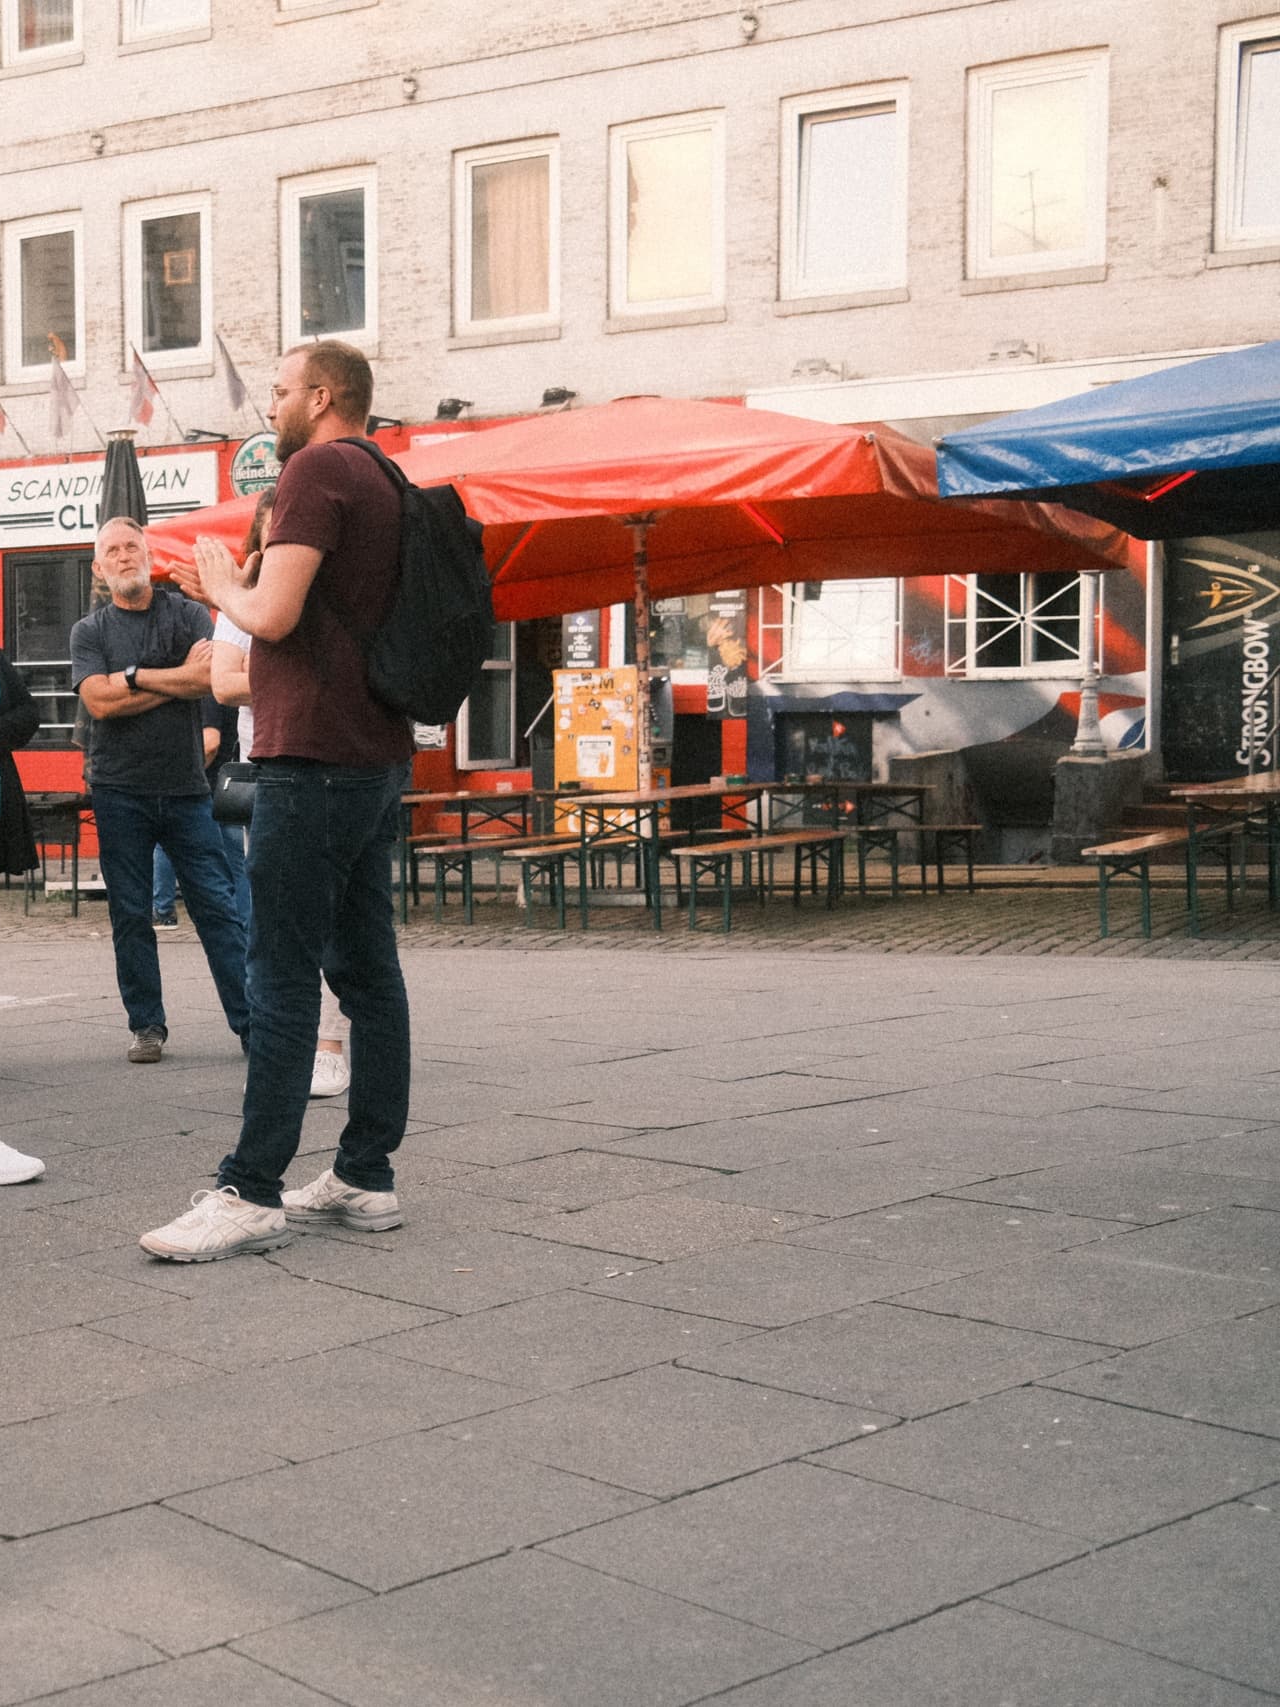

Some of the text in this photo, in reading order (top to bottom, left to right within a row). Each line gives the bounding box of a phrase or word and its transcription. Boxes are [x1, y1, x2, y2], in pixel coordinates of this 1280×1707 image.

[7, 468, 190, 502] SCANDIIAN
[233, 463, 282, 481] Heineke
[58, 504, 100, 531] CL
[1235, 617, 1272, 767] STRONGBOW
